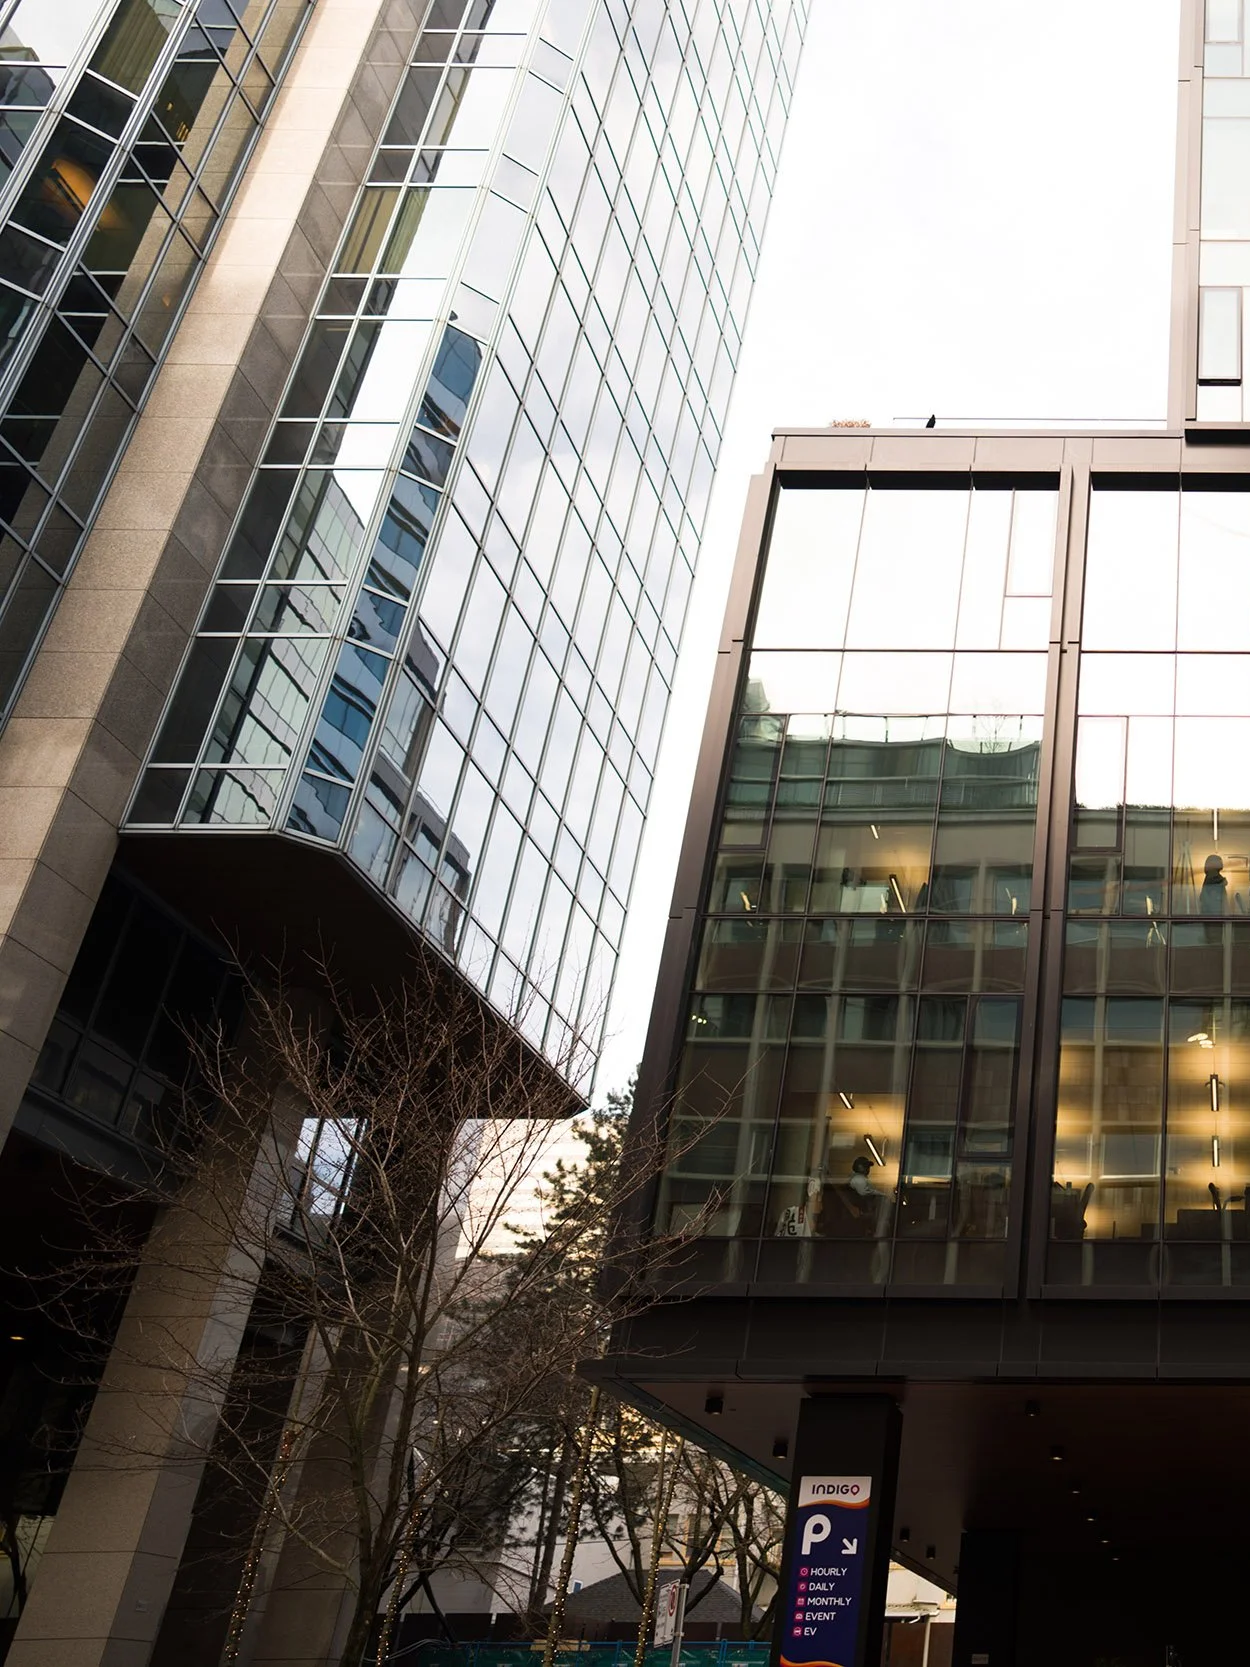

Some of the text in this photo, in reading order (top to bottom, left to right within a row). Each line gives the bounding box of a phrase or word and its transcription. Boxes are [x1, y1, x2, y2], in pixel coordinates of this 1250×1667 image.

[811, 1484, 860, 1496] INDIGO
[801, 1513, 832, 1556] P
[810, 1567, 848, 1576] HOURLY
[809, 1582, 835, 1591] DAILY
[807, 1597, 852, 1606] MONTHLY
[805, 1612, 836, 1621] EVENT
[804, 1627, 817, 1636] EV
